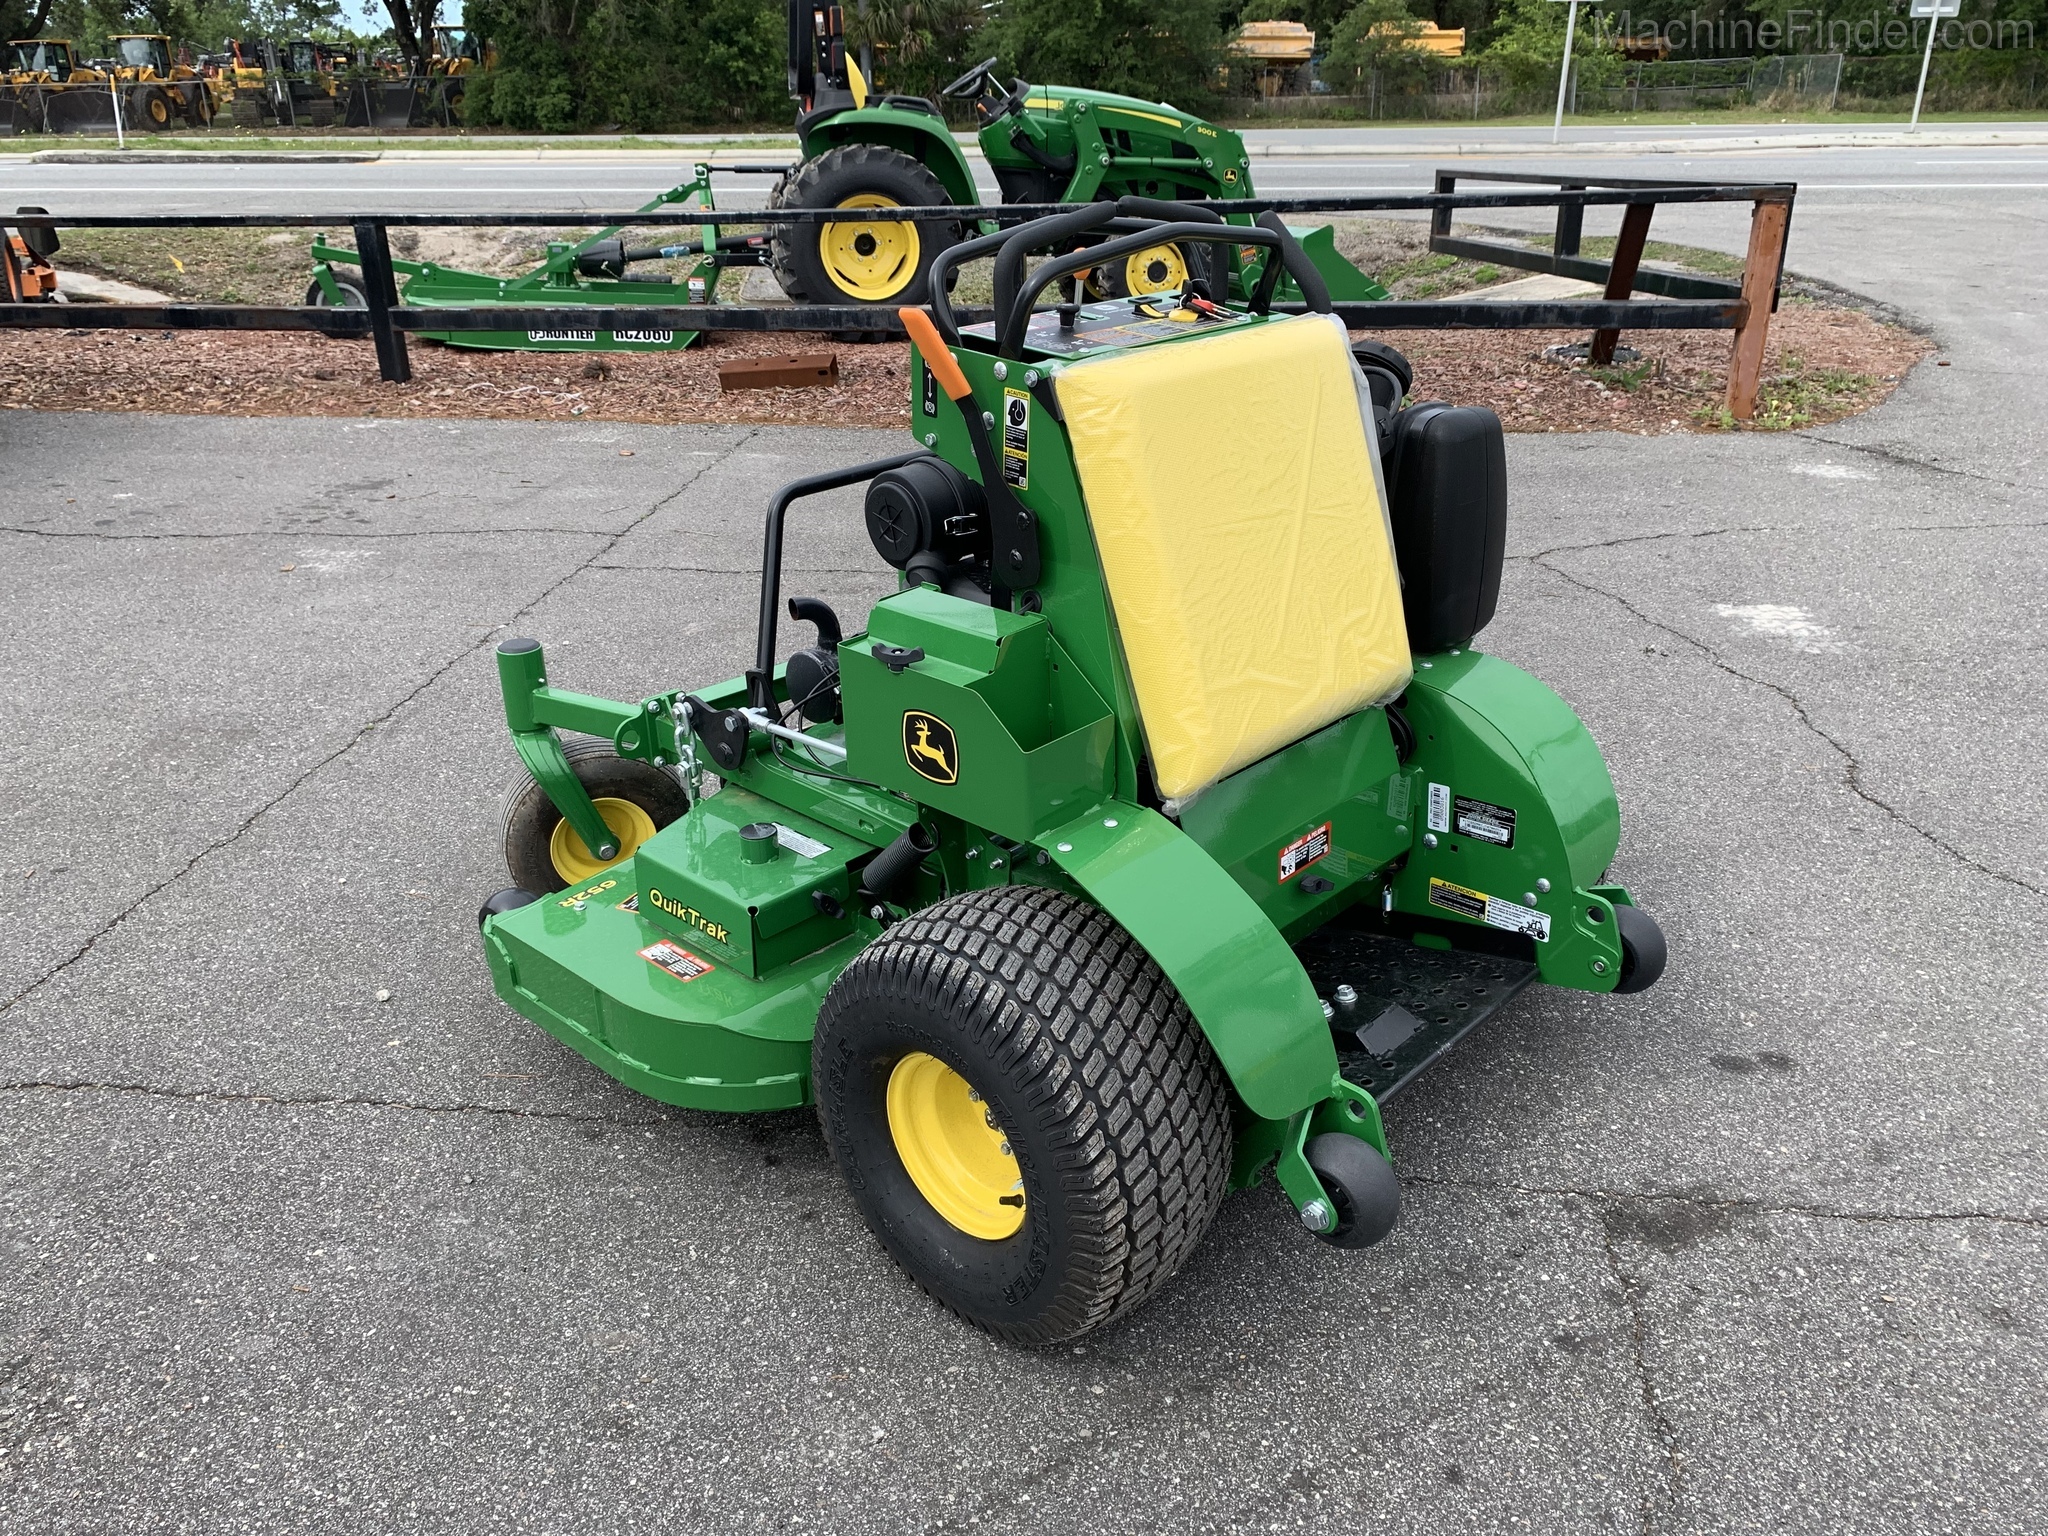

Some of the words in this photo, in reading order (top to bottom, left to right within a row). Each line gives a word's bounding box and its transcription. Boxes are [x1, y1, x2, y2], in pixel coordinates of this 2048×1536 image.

[1009, 389, 1029, 399] CAUTION
[557, 879, 618, 908] 652R
[649, 888, 730, 946] QuikTrak
